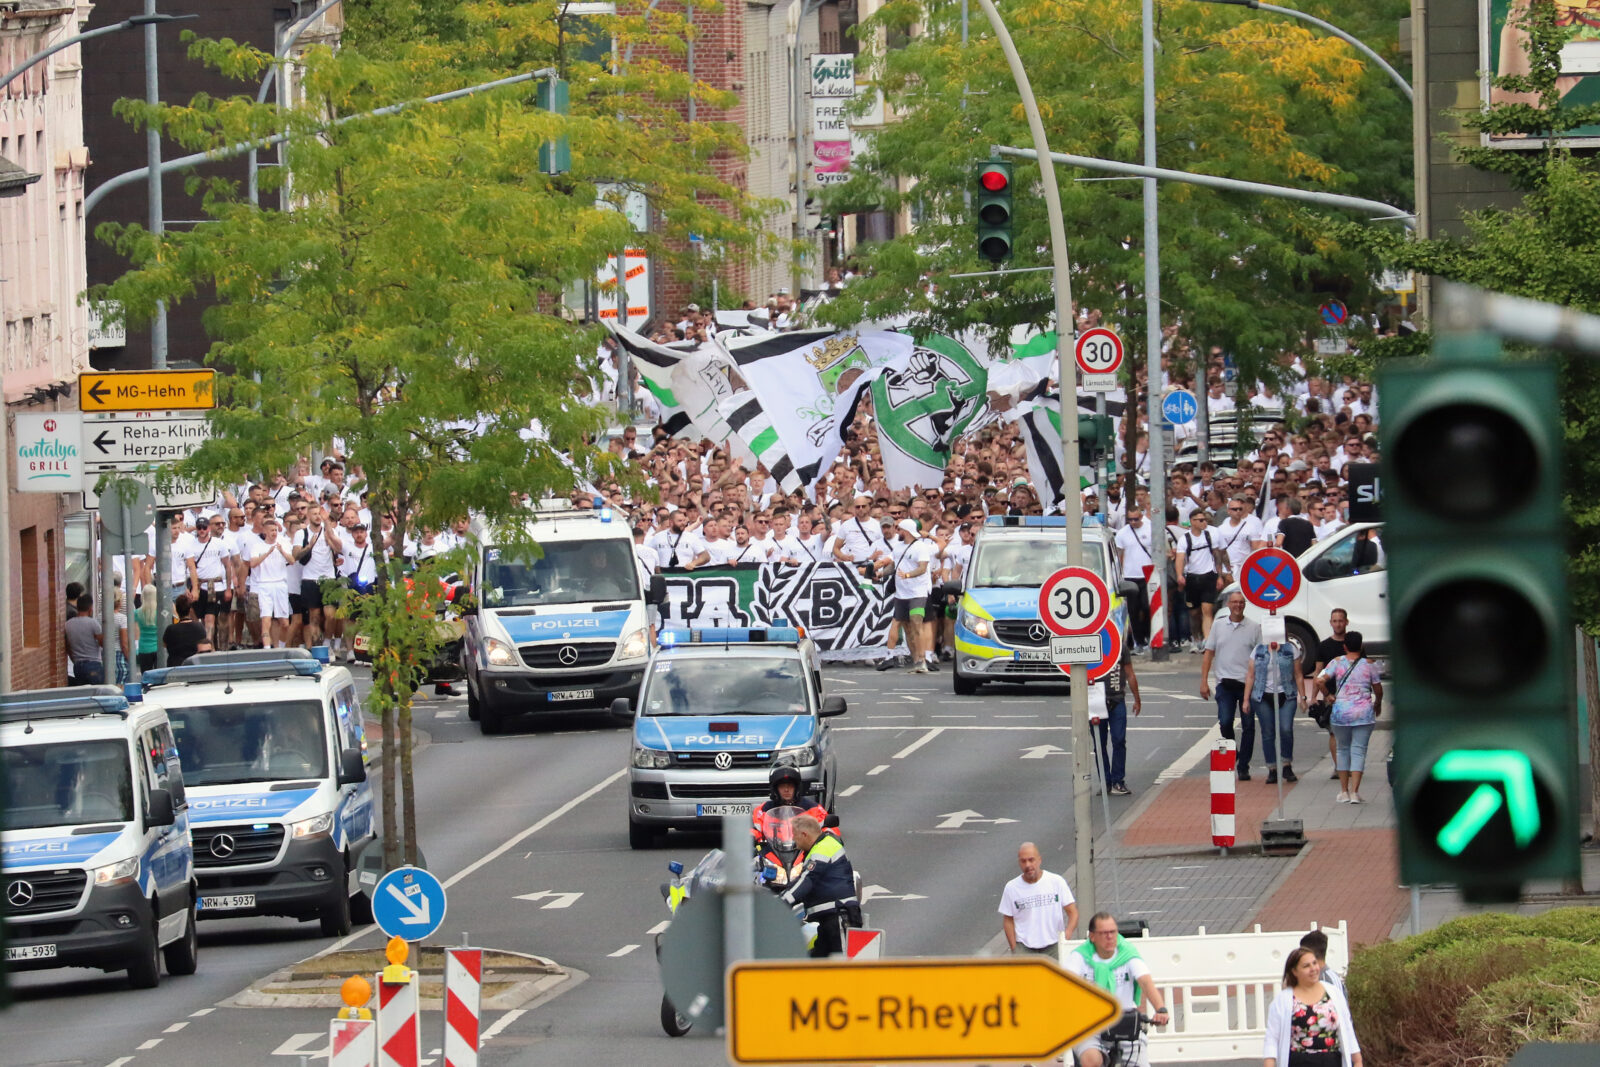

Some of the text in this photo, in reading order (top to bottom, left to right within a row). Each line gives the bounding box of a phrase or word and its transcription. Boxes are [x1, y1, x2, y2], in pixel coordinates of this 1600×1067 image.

[813, 58, 852, 84] Grill
[816, 106, 846, 117] FREE
[817, 120, 845, 130] TIME
[816, 173, 849, 183] Gyros
[1086, 342, 1112, 363] 30
[117, 384, 186, 399] MG-Hehn
[123, 424, 210, 438] Reha-Klinik
[19, 437, 77, 462] antalya
[29, 461, 68, 471] GRILL
[1004, 599, 1038, 609] POL
[1054, 587, 1094, 619] 30
[531, 619, 600, 630] POLIZEI
[1054, 645, 1097, 655] Lärmschutz
[684, 734, 764, 746] POLIZEI
[702, 805, 718, 815] NRW
[202, 897, 218, 908] NRW
[789, 993, 1020, 1038] MG-Rheydt
